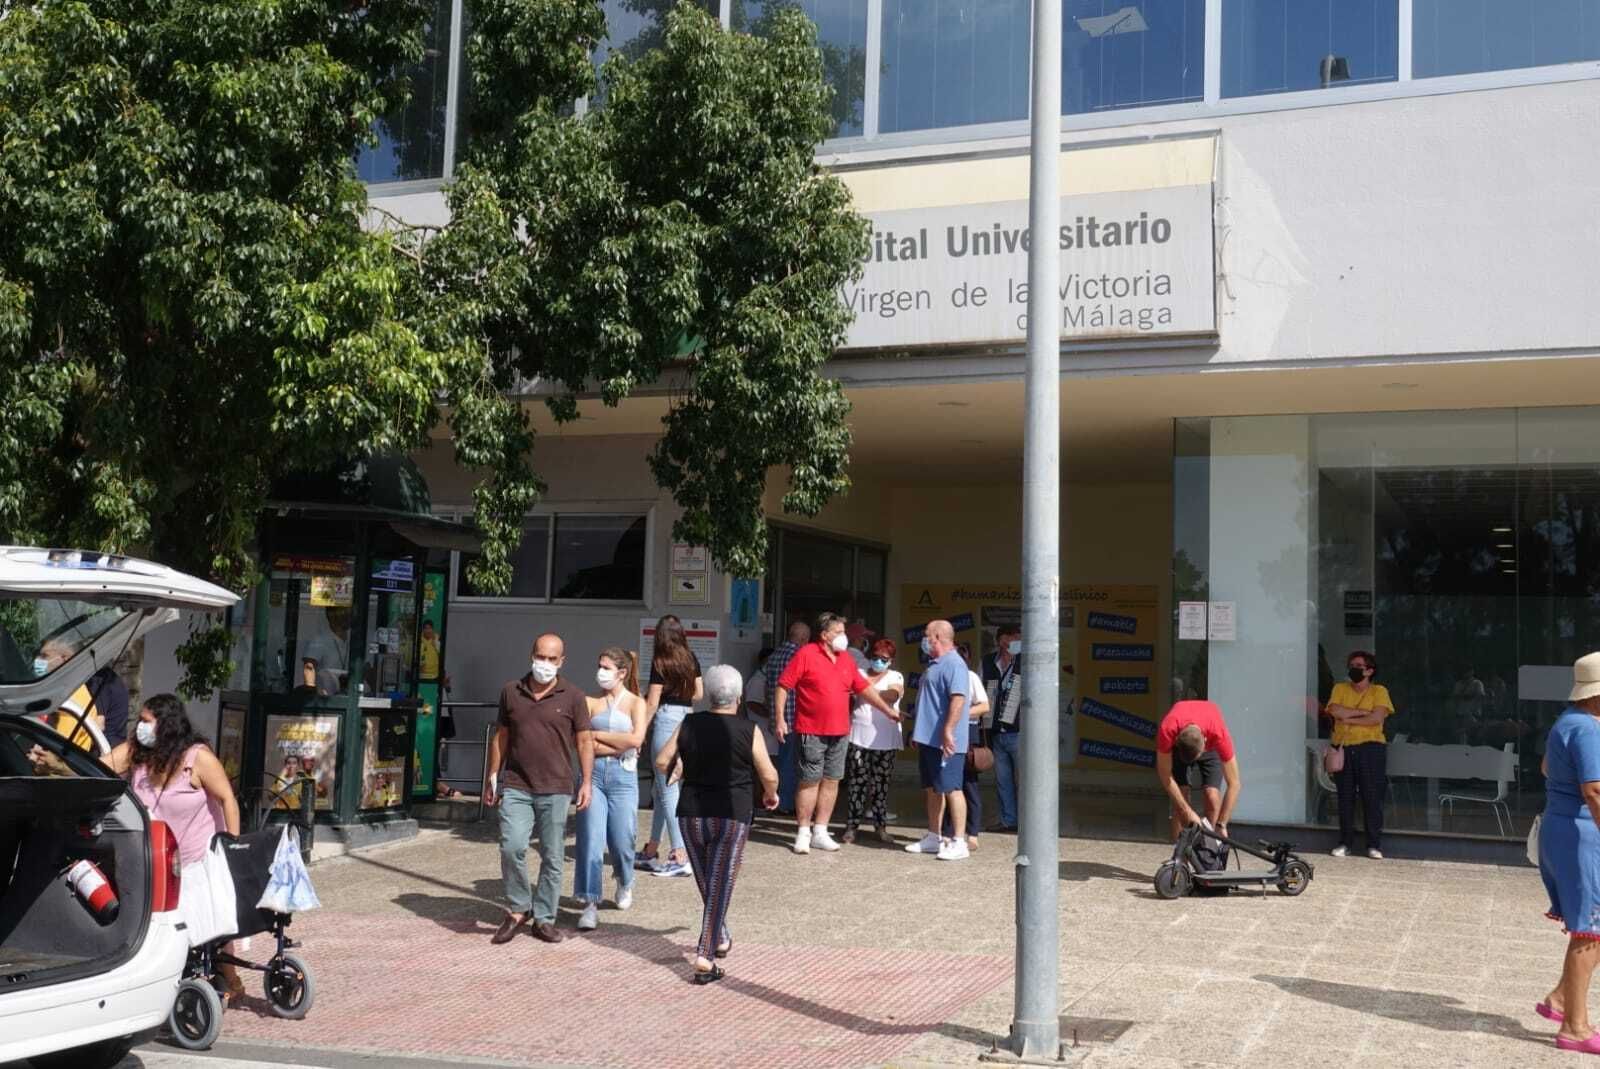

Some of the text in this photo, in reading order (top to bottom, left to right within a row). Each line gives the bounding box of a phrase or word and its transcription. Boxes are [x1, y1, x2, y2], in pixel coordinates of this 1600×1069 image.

[946, 211, 1171, 258] Univesitario
[841, 269, 1172, 318] Virgen de la Victoria
[1063, 303, 1172, 331] Málaga
